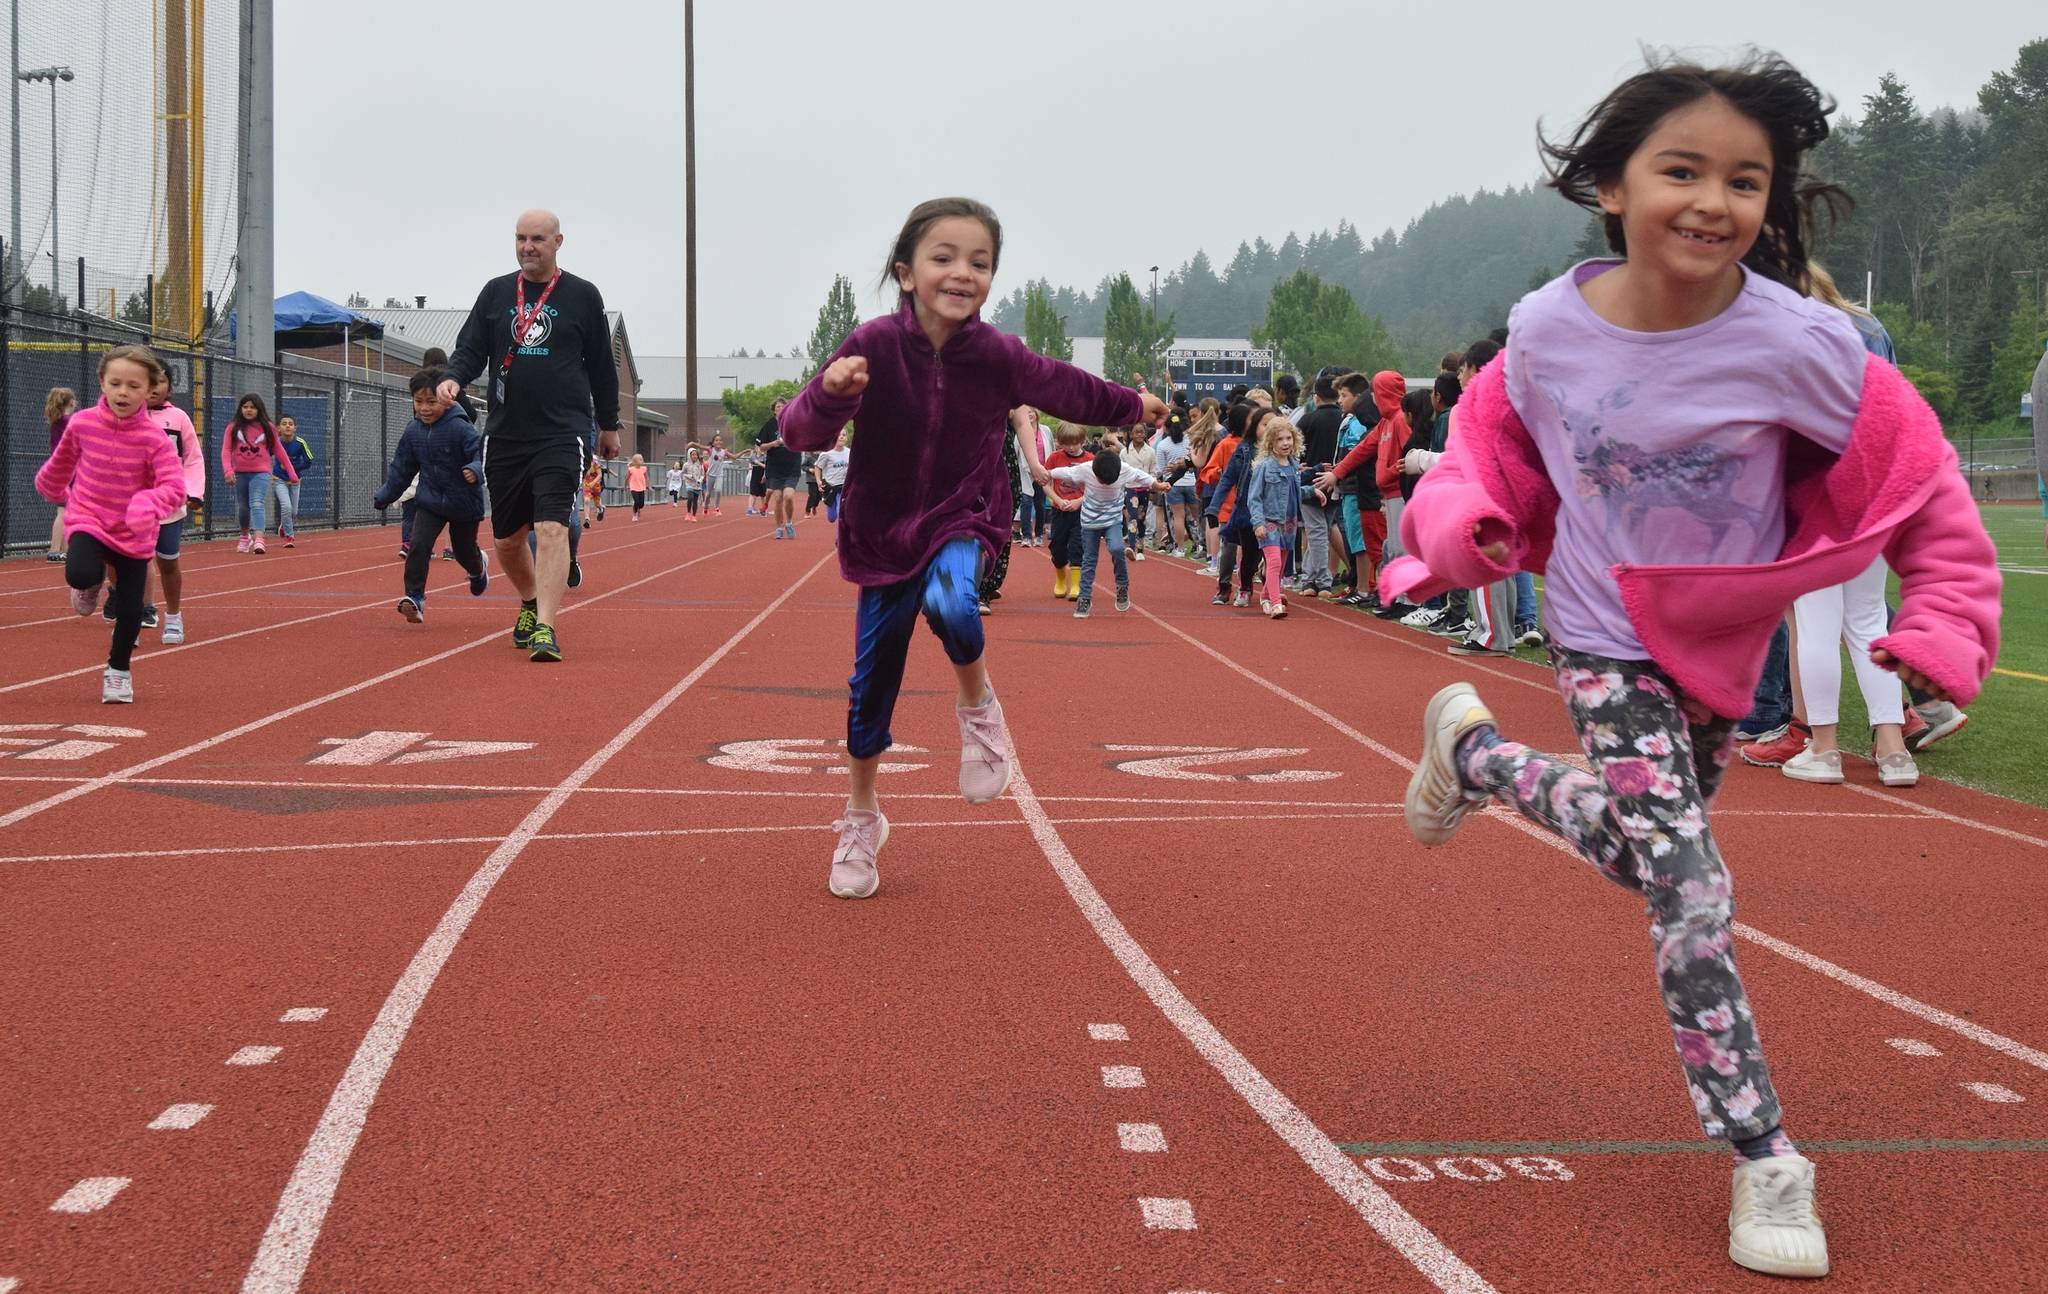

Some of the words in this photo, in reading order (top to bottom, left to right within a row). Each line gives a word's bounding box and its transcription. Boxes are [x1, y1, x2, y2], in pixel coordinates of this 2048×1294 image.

[1250, 360, 1270, 368] GUEST
[305, 731, 538, 765] 4
[1104, 743, 1344, 783] 2
[1363, 1156, 1576, 1182] 800
